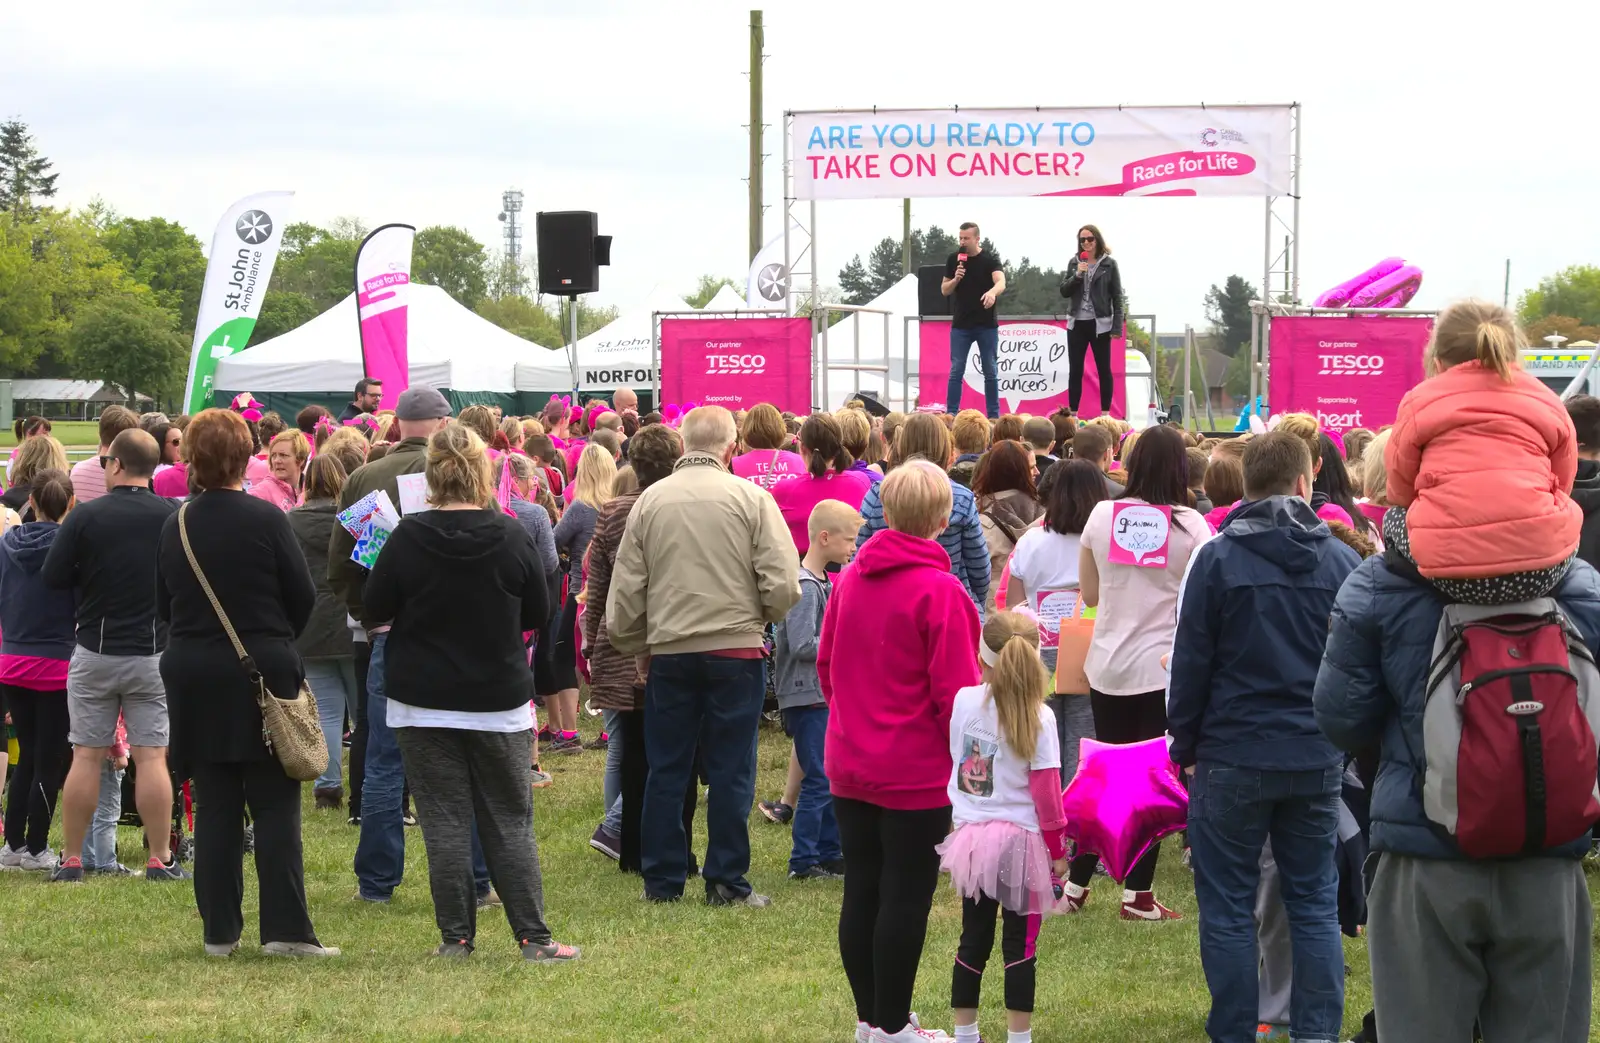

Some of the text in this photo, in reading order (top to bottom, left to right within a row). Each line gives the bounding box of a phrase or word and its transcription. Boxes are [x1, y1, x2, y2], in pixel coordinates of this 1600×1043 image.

[808, 122, 1095, 149] ARE YOU READY TO
[806, 152, 1085, 179] TAKE ON CANCER?
[1133, 154, 1238, 182] Race for Life
[225, 248, 250, 310] St John
[241, 251, 262, 312] Ambulance
[366, 279, 384, 290] Race
[383, 275, 395, 285] for
[598, 336, 651, 349] St John
[1000, 340, 1038, 353] cures
[706, 354, 766, 368] TESCO
[1019, 356, 1042, 372] all
[1318, 354, 1384, 369] TESCO
[586, 368, 661, 383] NORFOL
[1317, 396, 1348, 404] Supported
[1317, 410, 1362, 426] heart
[756, 462, 788, 472] TEAM
[1128, 542, 1158, 550] MAMA
